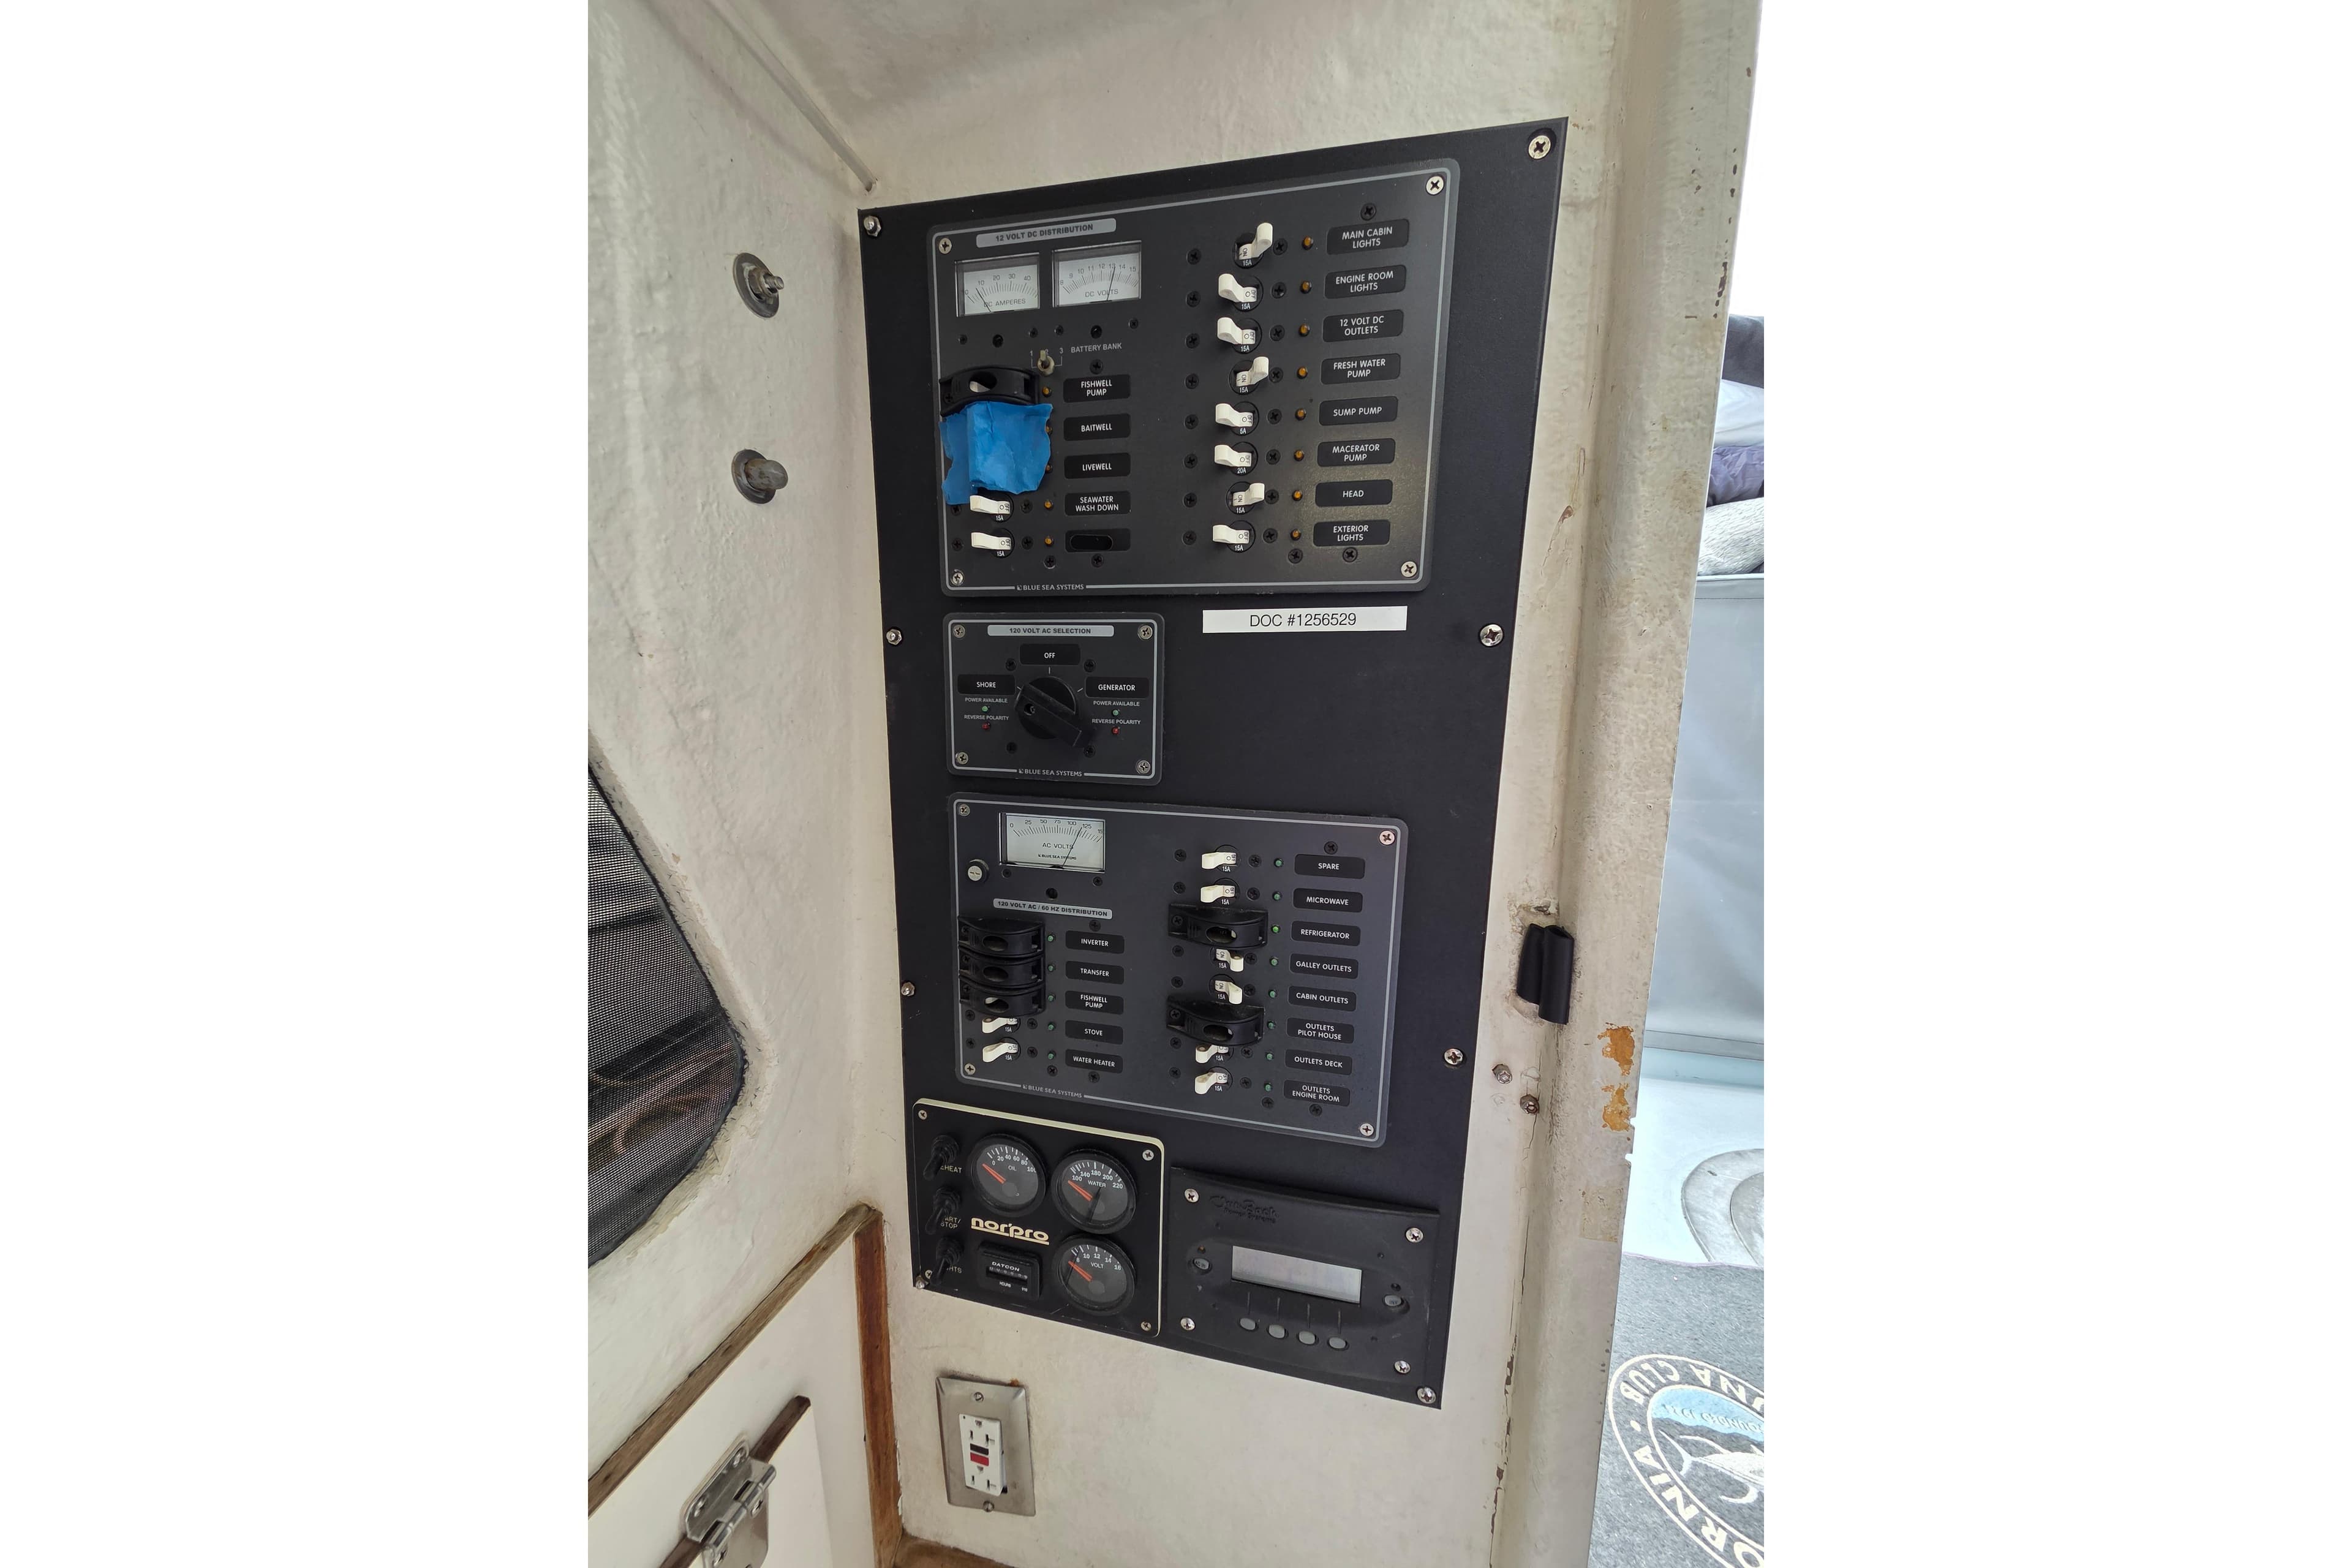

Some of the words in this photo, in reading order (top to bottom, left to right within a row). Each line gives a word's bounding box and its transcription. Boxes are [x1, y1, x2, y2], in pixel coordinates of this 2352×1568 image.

[1006, 232, 1025, 241] VOLT
[1039, 224, 1093, 237] DISTRIBUTION
[1342, 230, 1364, 240] MAIN
[1366, 227, 1393, 238] CABIN
[1352, 238, 1381, 249] LIGHTS
[1335, 273, 1365, 285] ENGINE
[1368, 270, 1393, 282] ROOM
[1350, 282, 1378, 293] LIGHTS
[1351, 316, 1370, 326] VOLT
[1372, 315, 1384, 324] DC
[1344, 325, 1378, 336] OUTLETS
[1071, 344, 1101, 353] BATTERY
[1333, 360, 1357, 370] FRESH
[1359, 358, 1385, 368] WATER
[1347, 369, 1371, 378] PUMP
[1081, 380, 1112, 388] FISHWELL
[1087, 388, 1107, 397] PUMP
[1333, 407, 1356, 417] SUMP
[1359, 406, 1382, 415] PUMP
[1081, 423, 1112, 432] BAITWELL
[1332, 443, 1380, 454] MACERATOR
[1344, 453, 1368, 462] PUMP
[1343, 489, 1364, 498] HEAD
[1333, 525, 1369, 533] EXTERIOR
[1337, 533, 1364, 542] LIGHTS
[1250, 614, 1283, 627] DOC
[1287, 612, 1357, 627] #1256529
[1306, 896, 1349, 906] MICROWAVE
[1061, 907, 1107, 916] DISTRIBUTION
[1300, 929, 1350, 940] REFRIGERATOR
[1295, 960, 1321, 970] GALLEY
[1322, 963, 1352, 973] OUTLETS
[1296, 992, 1317, 1001] CABIN
[1319, 994, 1348, 1005] OUTLETS
[1305, 1023, 1335, 1032] OUTLETS
[1298, 1029, 1317, 1038] PILOT
[1318, 1031, 1341, 1041] HOUSE
[1072, 1056, 1092, 1065] WATER
[1294, 1057, 1323, 1066] OUTLETS
[1324, 1059, 1343, 1068] DECK
[1058, 1090, 1082, 1098] SYSTEMS
[1302, 1085, 1330, 1095] OUTLETS
[1292, 1090, 1317, 1100] ENGINE
[1318, 1093, 1340, 1102] ROOM
[992, 1261, 1020, 1272] DATCON
[1619, 1360, 1679, 1405] CLUB
